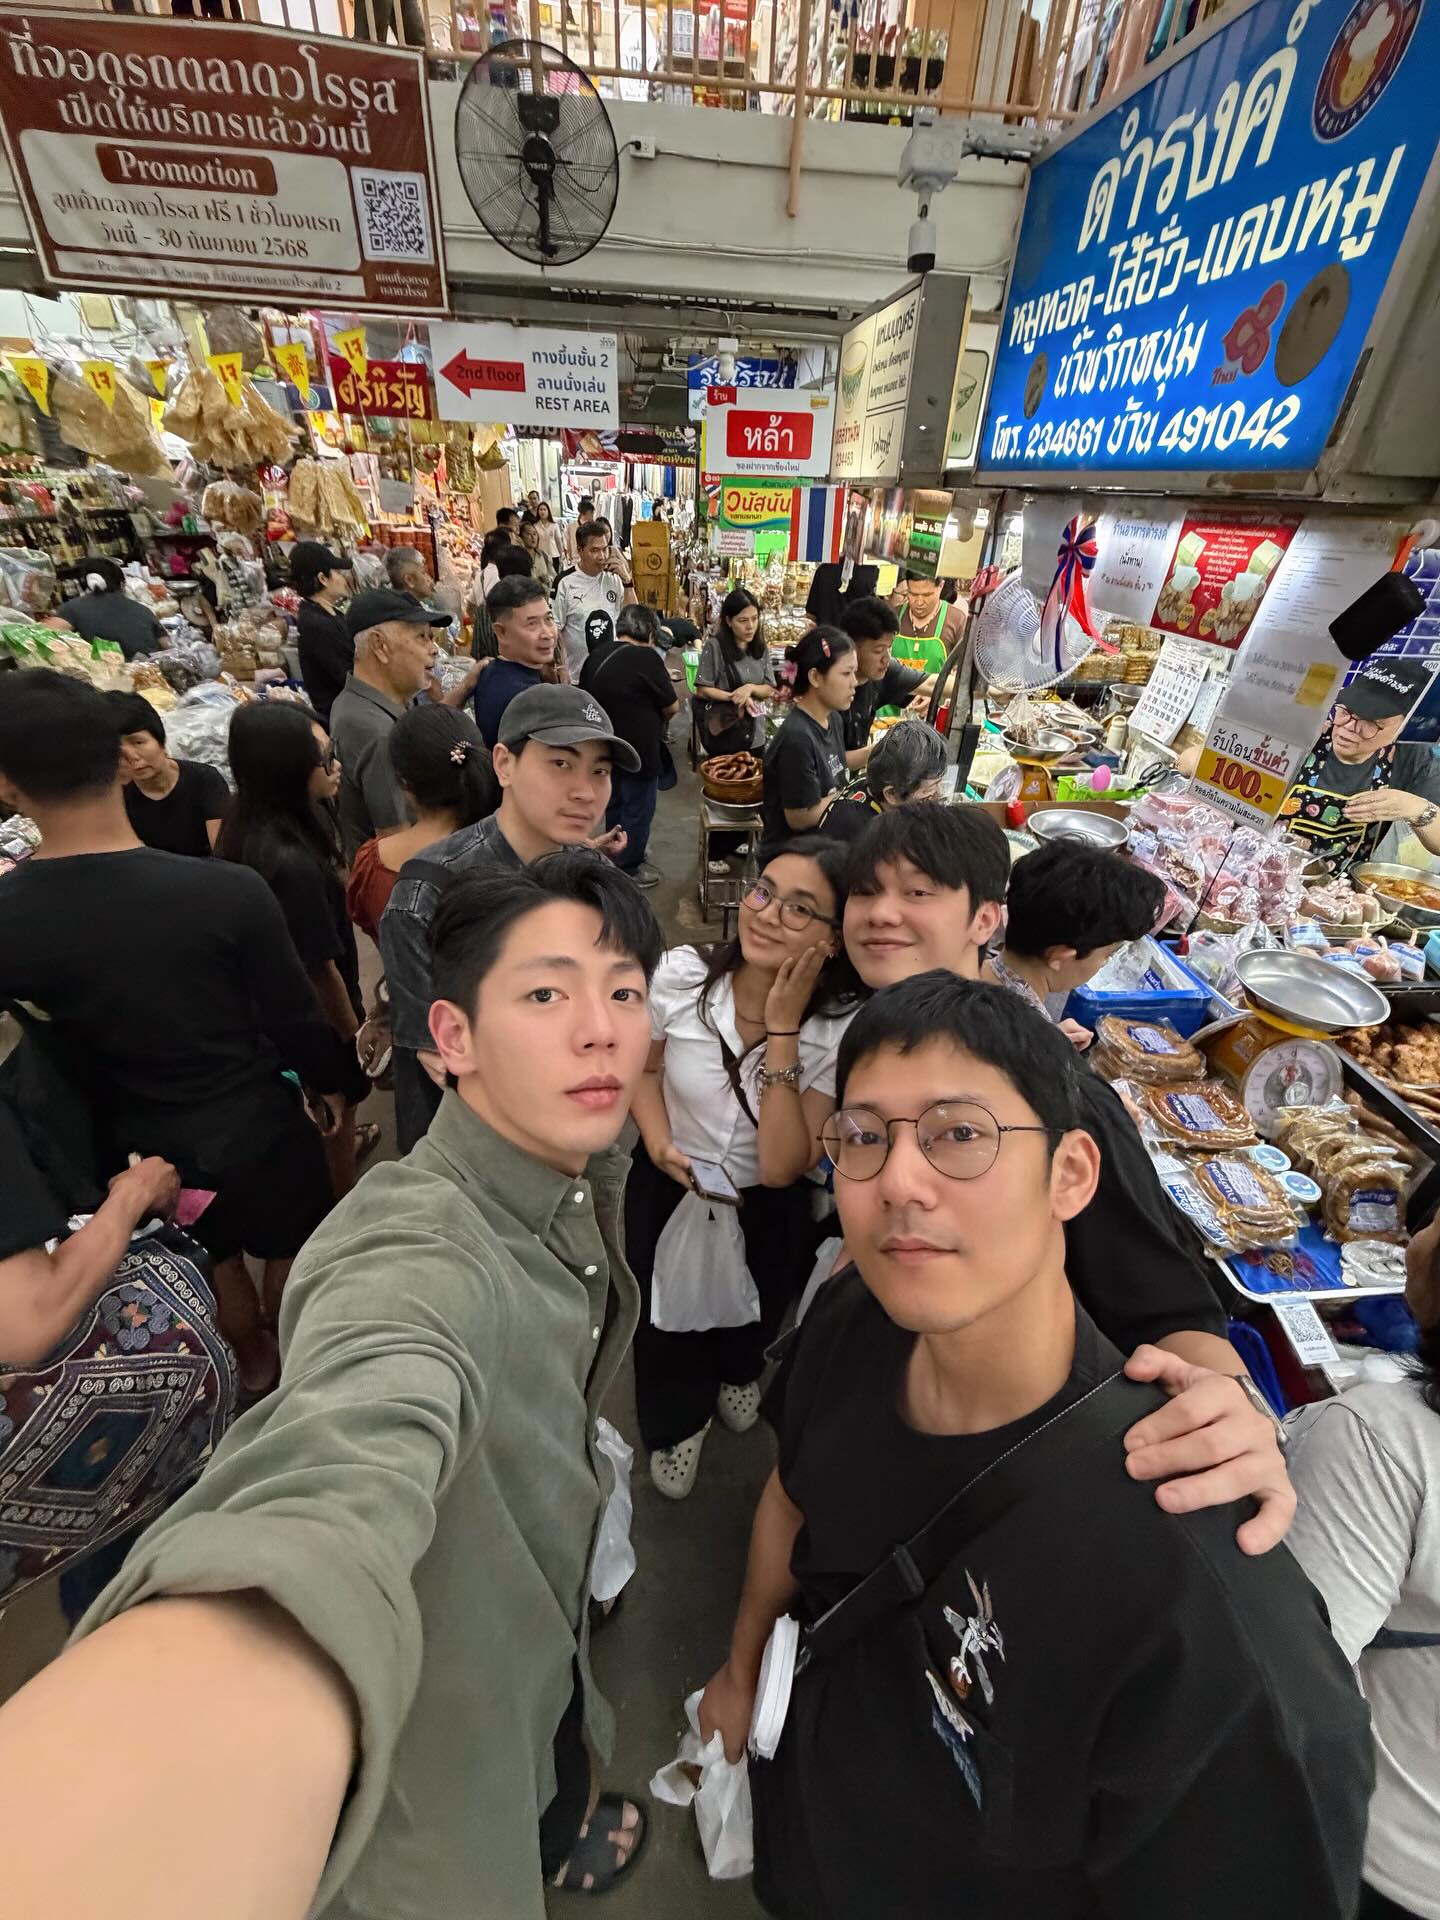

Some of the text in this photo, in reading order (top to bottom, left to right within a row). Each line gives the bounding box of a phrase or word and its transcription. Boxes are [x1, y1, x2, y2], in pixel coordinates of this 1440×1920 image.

[8, 18, 399, 115] ที่จอดรถตลาดวโรรส
[57, 86, 372, 155] เปิดให้บริการแล้ววันนี้
[116, 149, 259, 189] Promotion
[157, 227, 182, 249] 30
[261, 237, 309, 258] 2568
[531, 344, 610, 369] ทางขึ้นชั้น 2
[455, 364, 522, 382] 2nd floor
[536, 371, 606, 394] ลานนั่งเล่น
[535, 396, 611, 414] REST AREA
[743, 414, 794, 453] หล้า
[1024, 416, 1105, 459] 234661
[1155, 393, 1303, 455] 491042
[736, 461, 801, 473] ของฝากจากเชียงใหม่
[726, 490, 792, 513] วนัสนัน
[1210, 757, 1273, 804] 100.-
